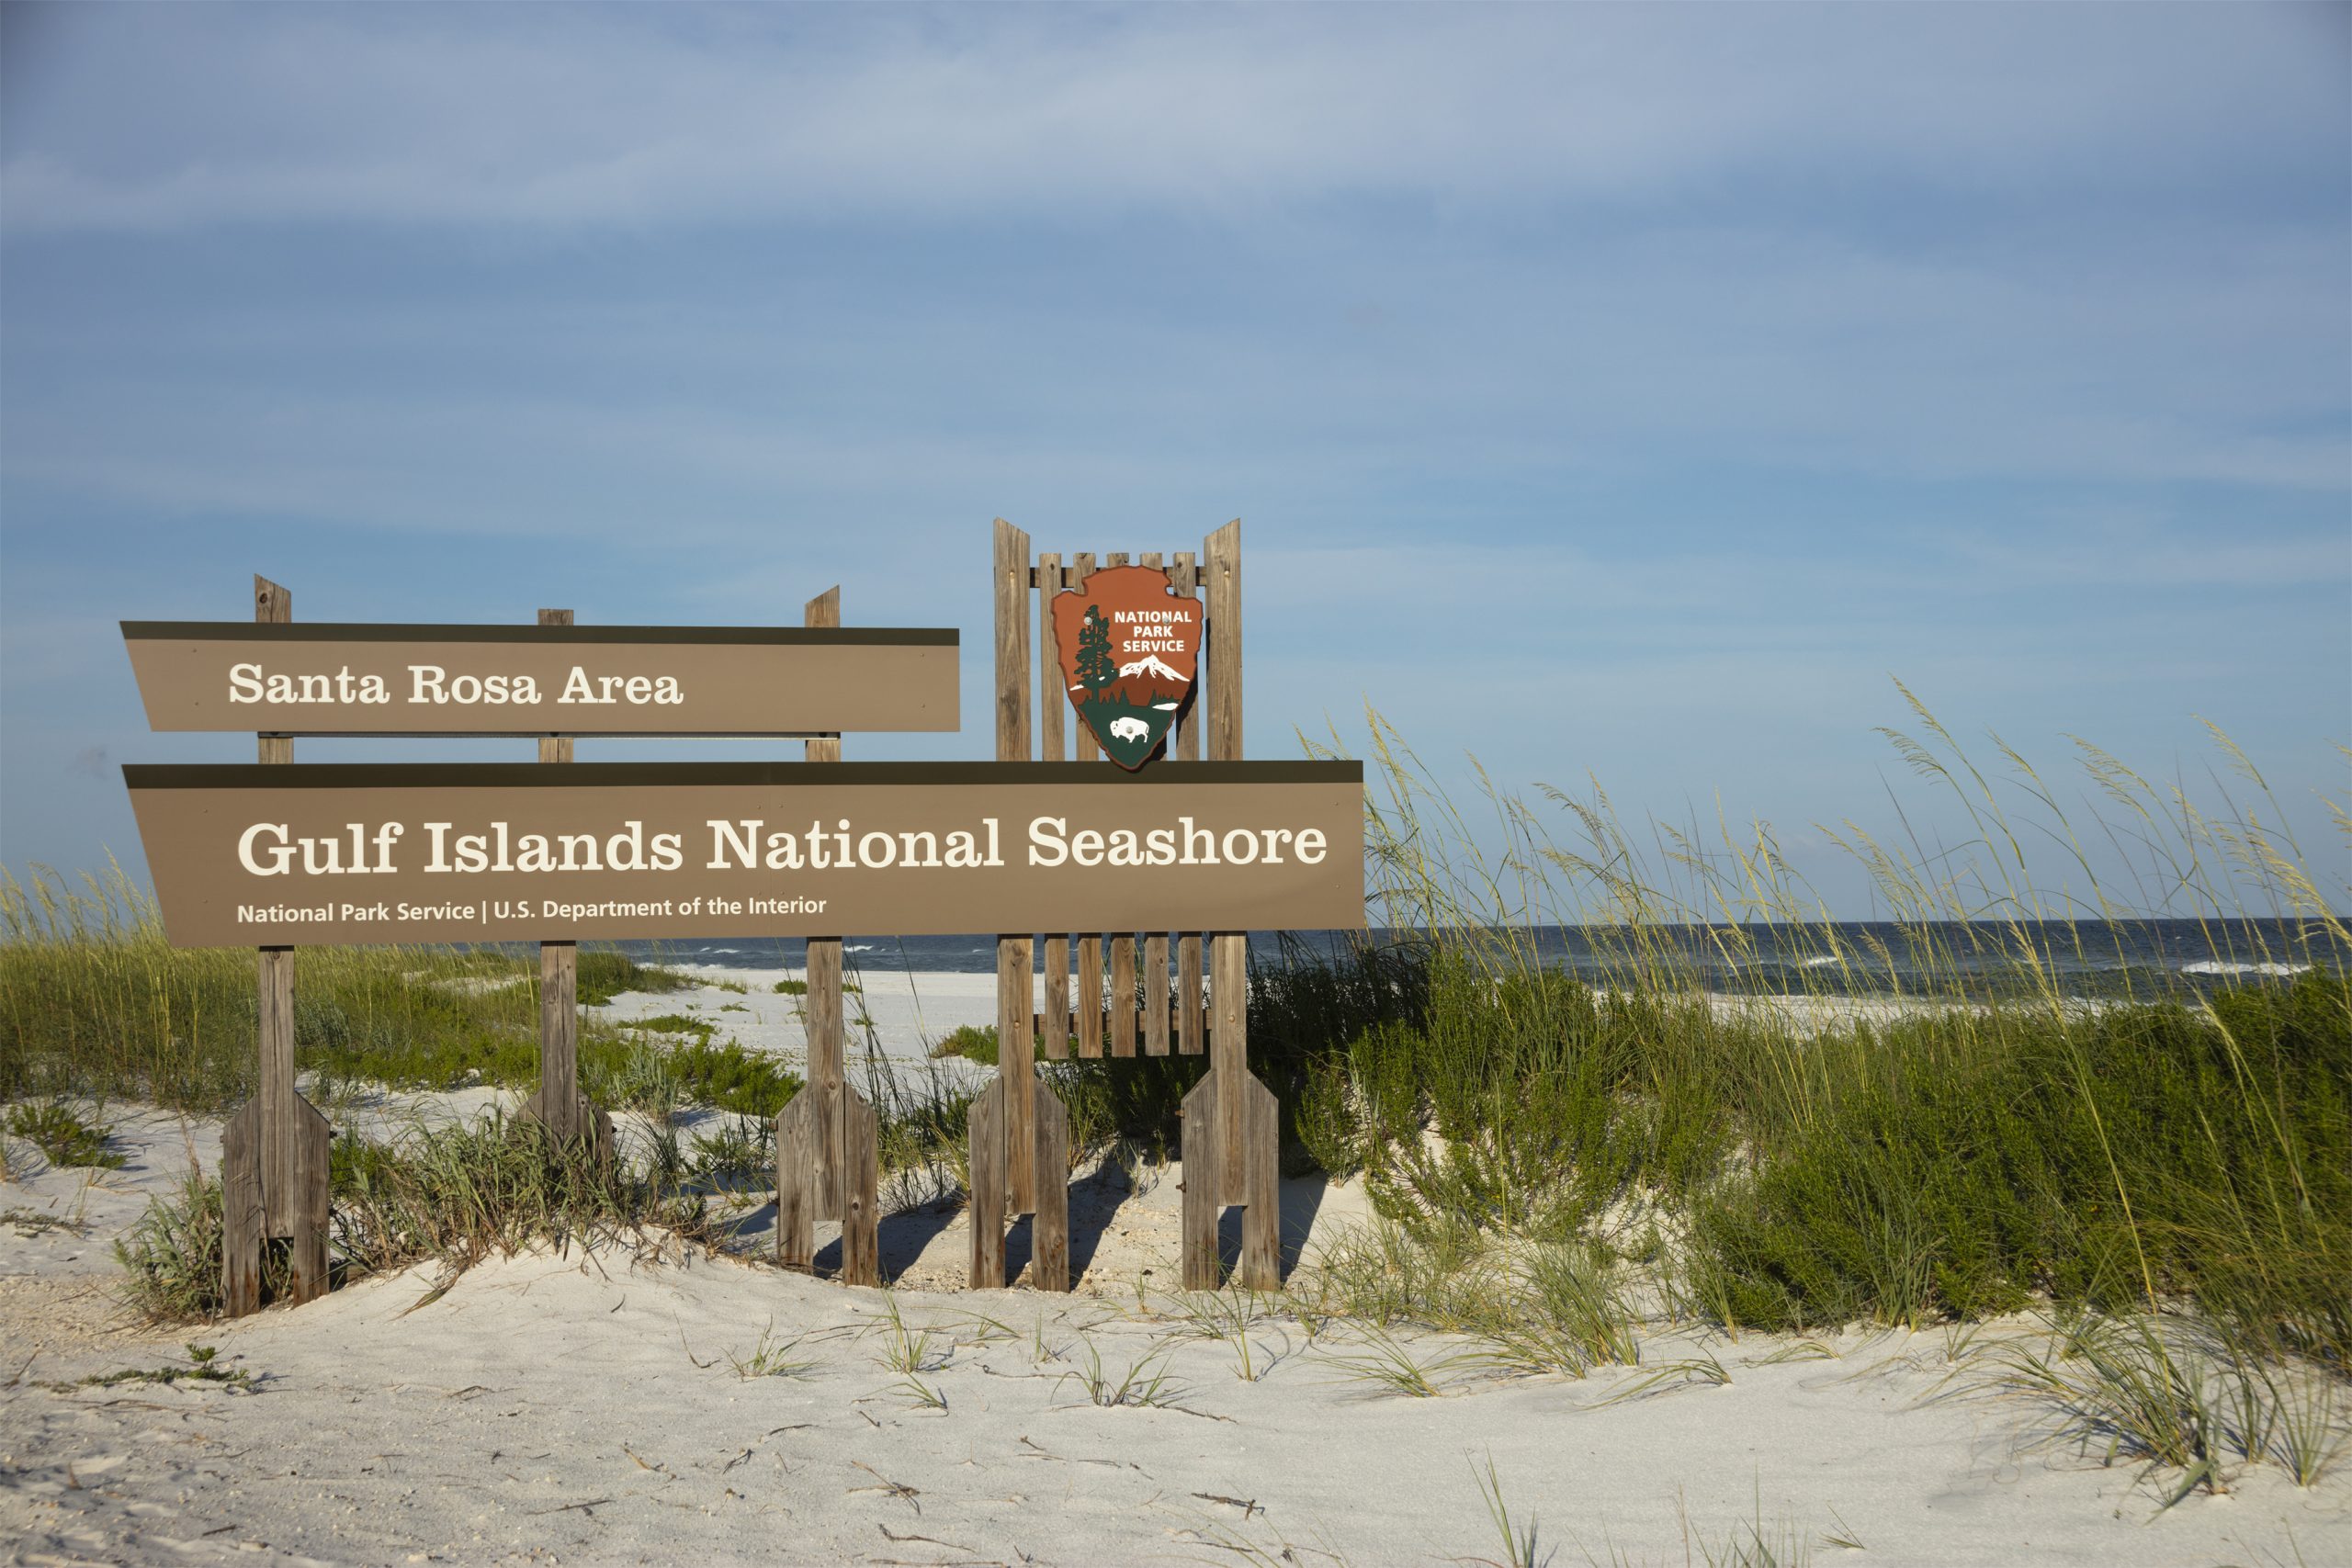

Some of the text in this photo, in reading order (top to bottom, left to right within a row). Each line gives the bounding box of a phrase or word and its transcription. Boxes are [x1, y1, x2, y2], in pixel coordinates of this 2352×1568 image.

[1114, 611, 1193, 624] NATIONAL
[1133, 626, 1173, 637] PARK
[1123, 639, 1184, 652] SERVICE
[229, 663, 684, 705] Santa Rosa Area
[238, 816, 1329, 876] Gulf Islands National Seashore
[237, 902, 334, 923] National
[341, 902, 390, 921] Park
[397, 901, 475, 920] Service
[493, 900, 536, 919] U.S.
[543, 899, 673, 922] Department
[678, 897, 701, 916] of
[707, 897, 742, 915] the
[749, 896, 827, 915] Interior
